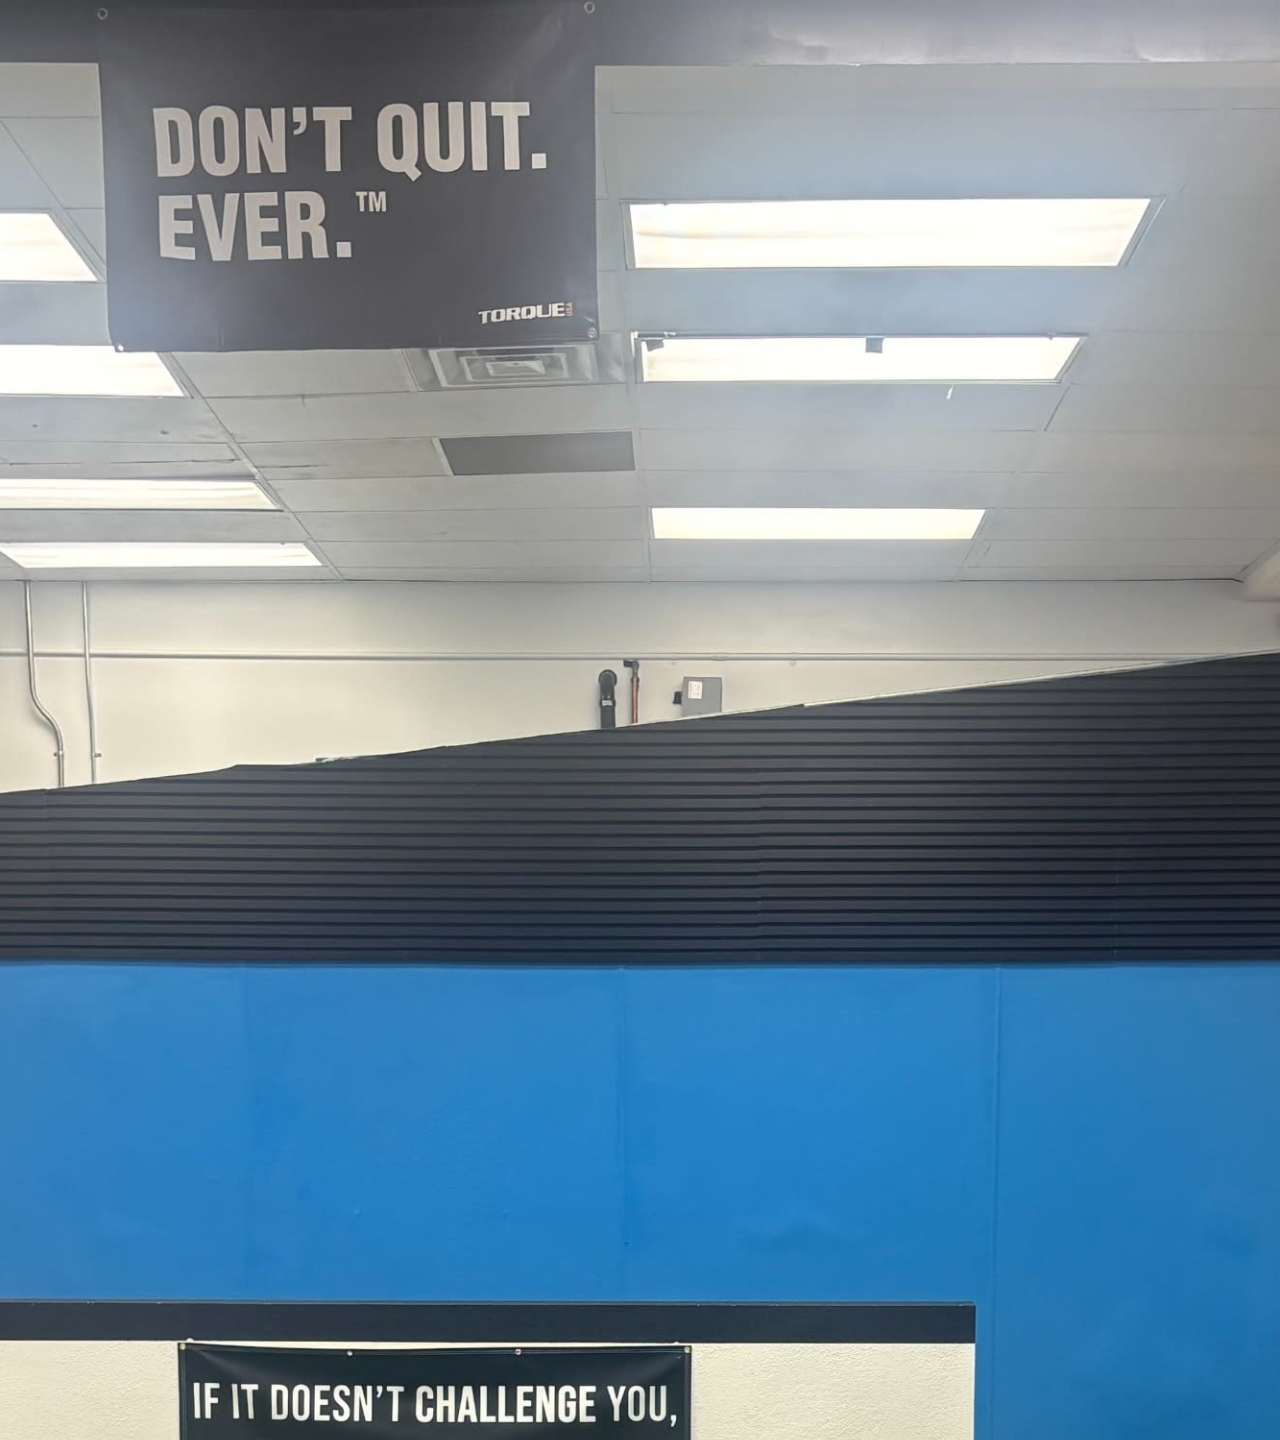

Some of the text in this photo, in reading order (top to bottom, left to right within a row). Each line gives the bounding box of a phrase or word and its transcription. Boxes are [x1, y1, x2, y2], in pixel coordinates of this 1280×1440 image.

[152, 101, 548, 181] DON'T QUIT.
[158, 191, 353, 262] EVER.
[478, 302, 565, 324] TORQUE
[193, 1382, 678, 1427] IF IT DOESN'T CHALLENGE YOU,
